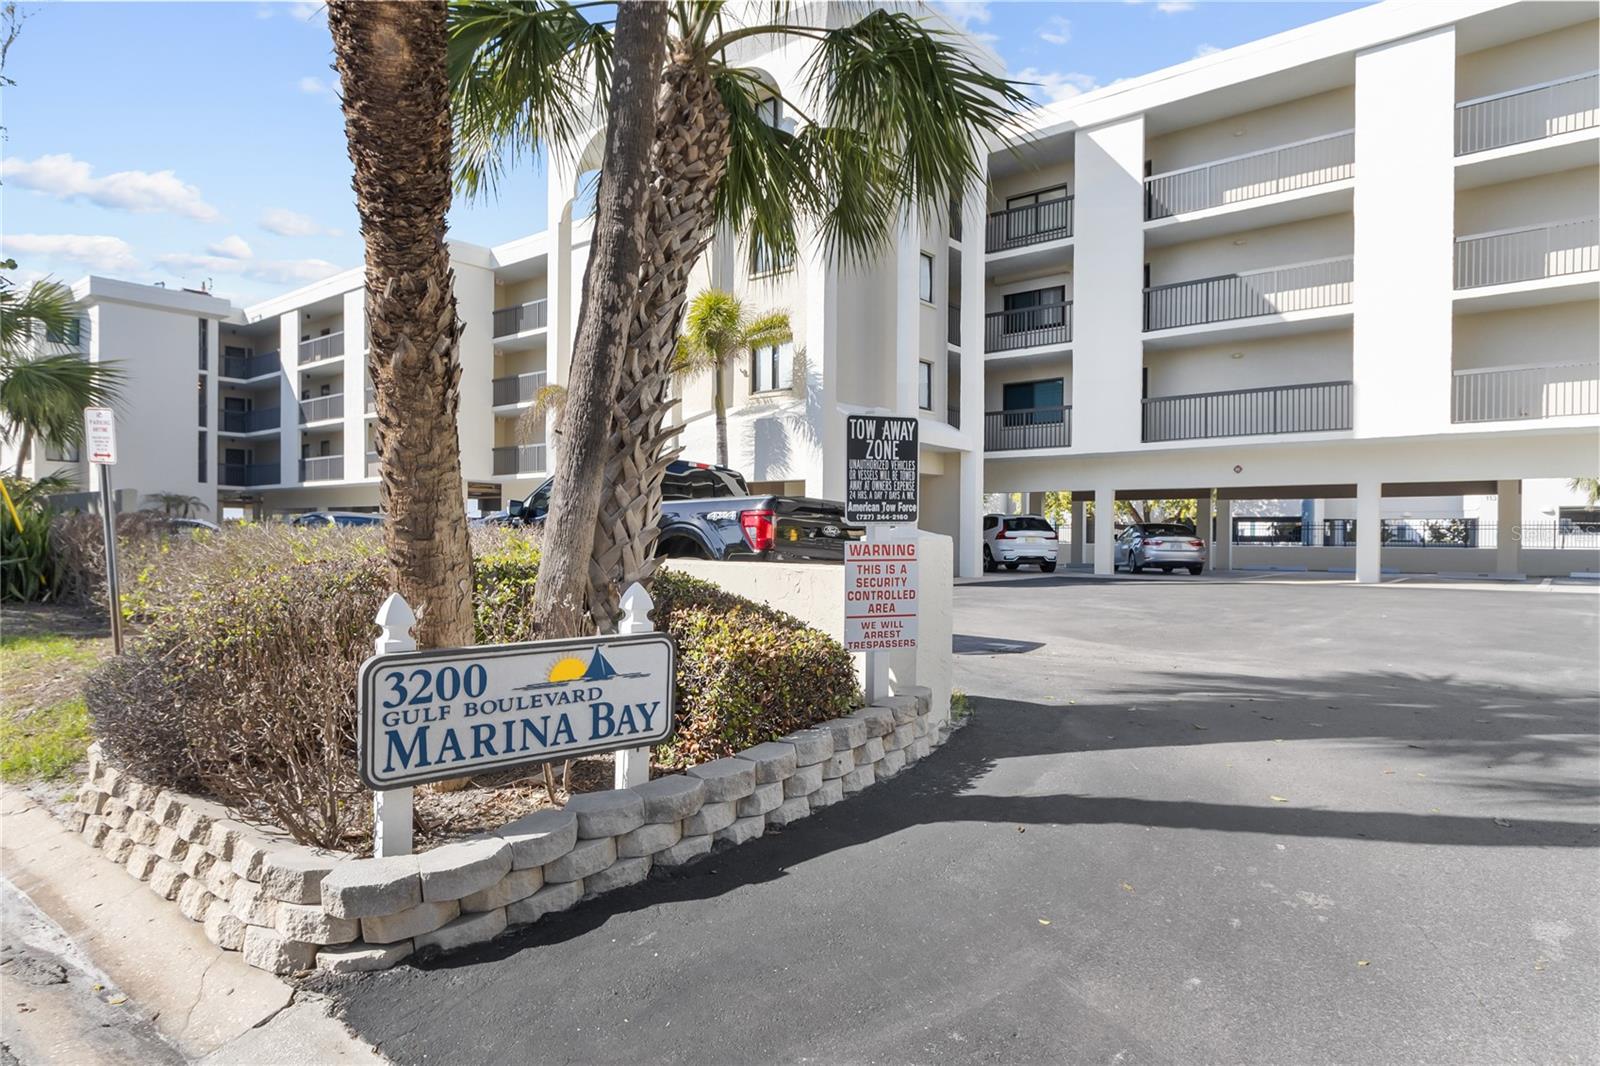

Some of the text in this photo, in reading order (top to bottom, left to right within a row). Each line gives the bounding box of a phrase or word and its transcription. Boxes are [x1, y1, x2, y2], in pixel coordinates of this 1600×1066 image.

[849, 419, 916, 441] TOW AWAY
[866, 439, 900, 460] ZONE
[848, 459, 915, 470] UNAUTHORIZED VEHICLES
[849, 470, 915, 480] OR VESSELS WILL BE TOWED
[849, 481, 862, 490] AWAY
[864, 481, 870, 490] AT
[894, 481, 915, 491] EXPENSE
[849, 491, 856, 499] 24
[874, 491, 883, 499] DAY
[889, 491, 900, 499] DAYS
[848, 501, 917, 513] American Tow Force
[849, 544, 915, 556] WARNING
[857, 565, 907, 574] THIS IS A
[856, 577, 907, 588] SECURITY
[847, 590, 916, 601] CONTROLLED
[868, 603, 896, 614] AREA
[881, 621, 904, 629] WILL
[864, 630, 901, 639] ARREST
[848, 639, 916, 649] TRESPASSERS
[382, 664, 488, 709] 3200
[382, 686, 603, 727] GULF BOULEVARD
[381, 701, 661, 774] MARINA BAY
